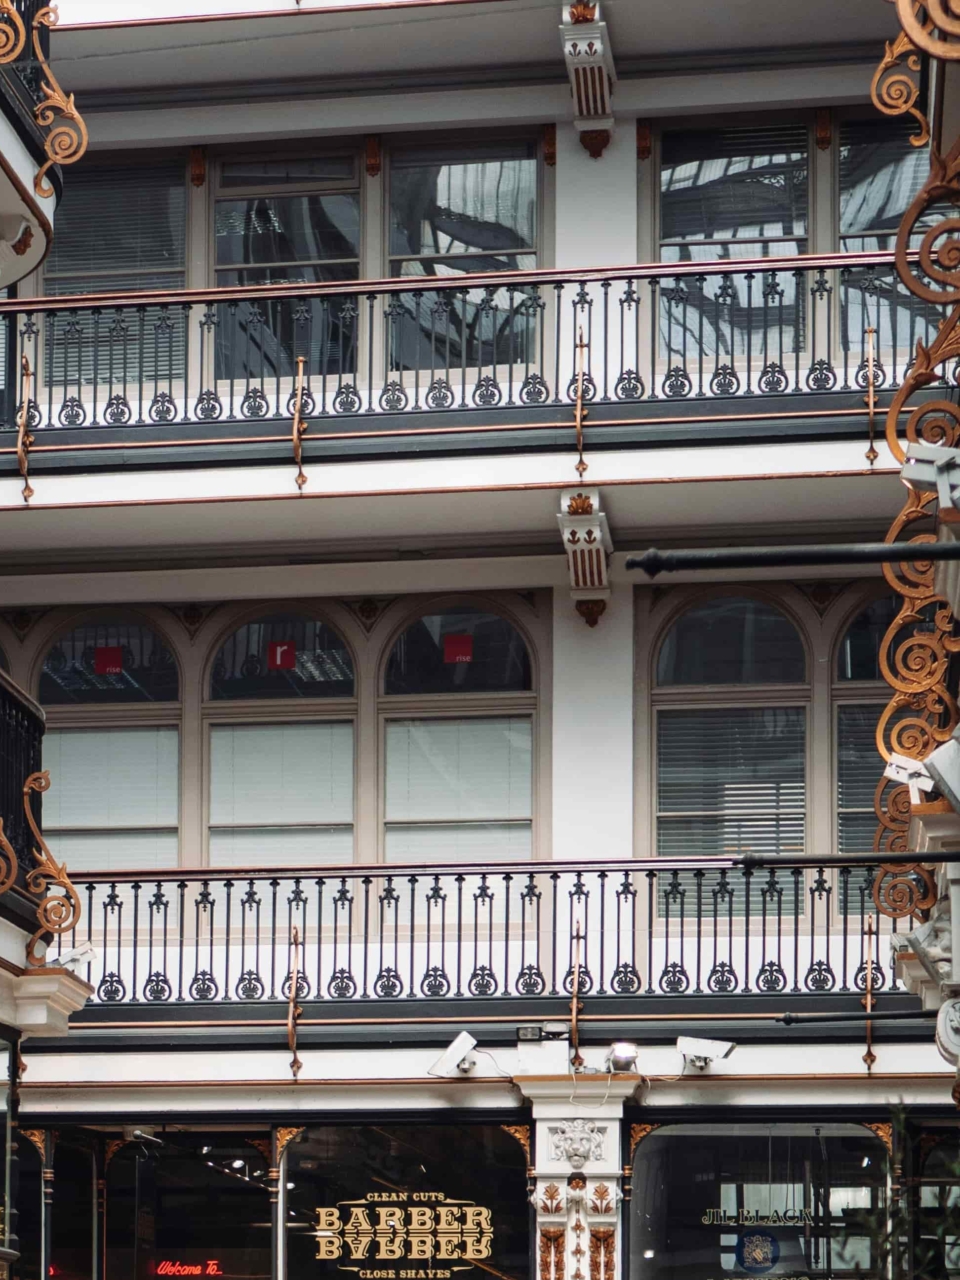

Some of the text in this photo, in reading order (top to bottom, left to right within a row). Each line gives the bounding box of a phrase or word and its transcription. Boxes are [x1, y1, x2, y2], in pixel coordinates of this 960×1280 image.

[276, 646, 288, 665] r
[456, 653, 471, 662] rise
[106, 665, 121, 673] rise
[367, 1192, 445, 1202] CLEAN CUTS
[315, 1206, 494, 1233] BARBER
[701, 1208, 814, 1225] JIL BLACK
[156, 1260, 200, 1275] Welcome
[359, 1269, 452, 1279] CLOSE SHAVES
